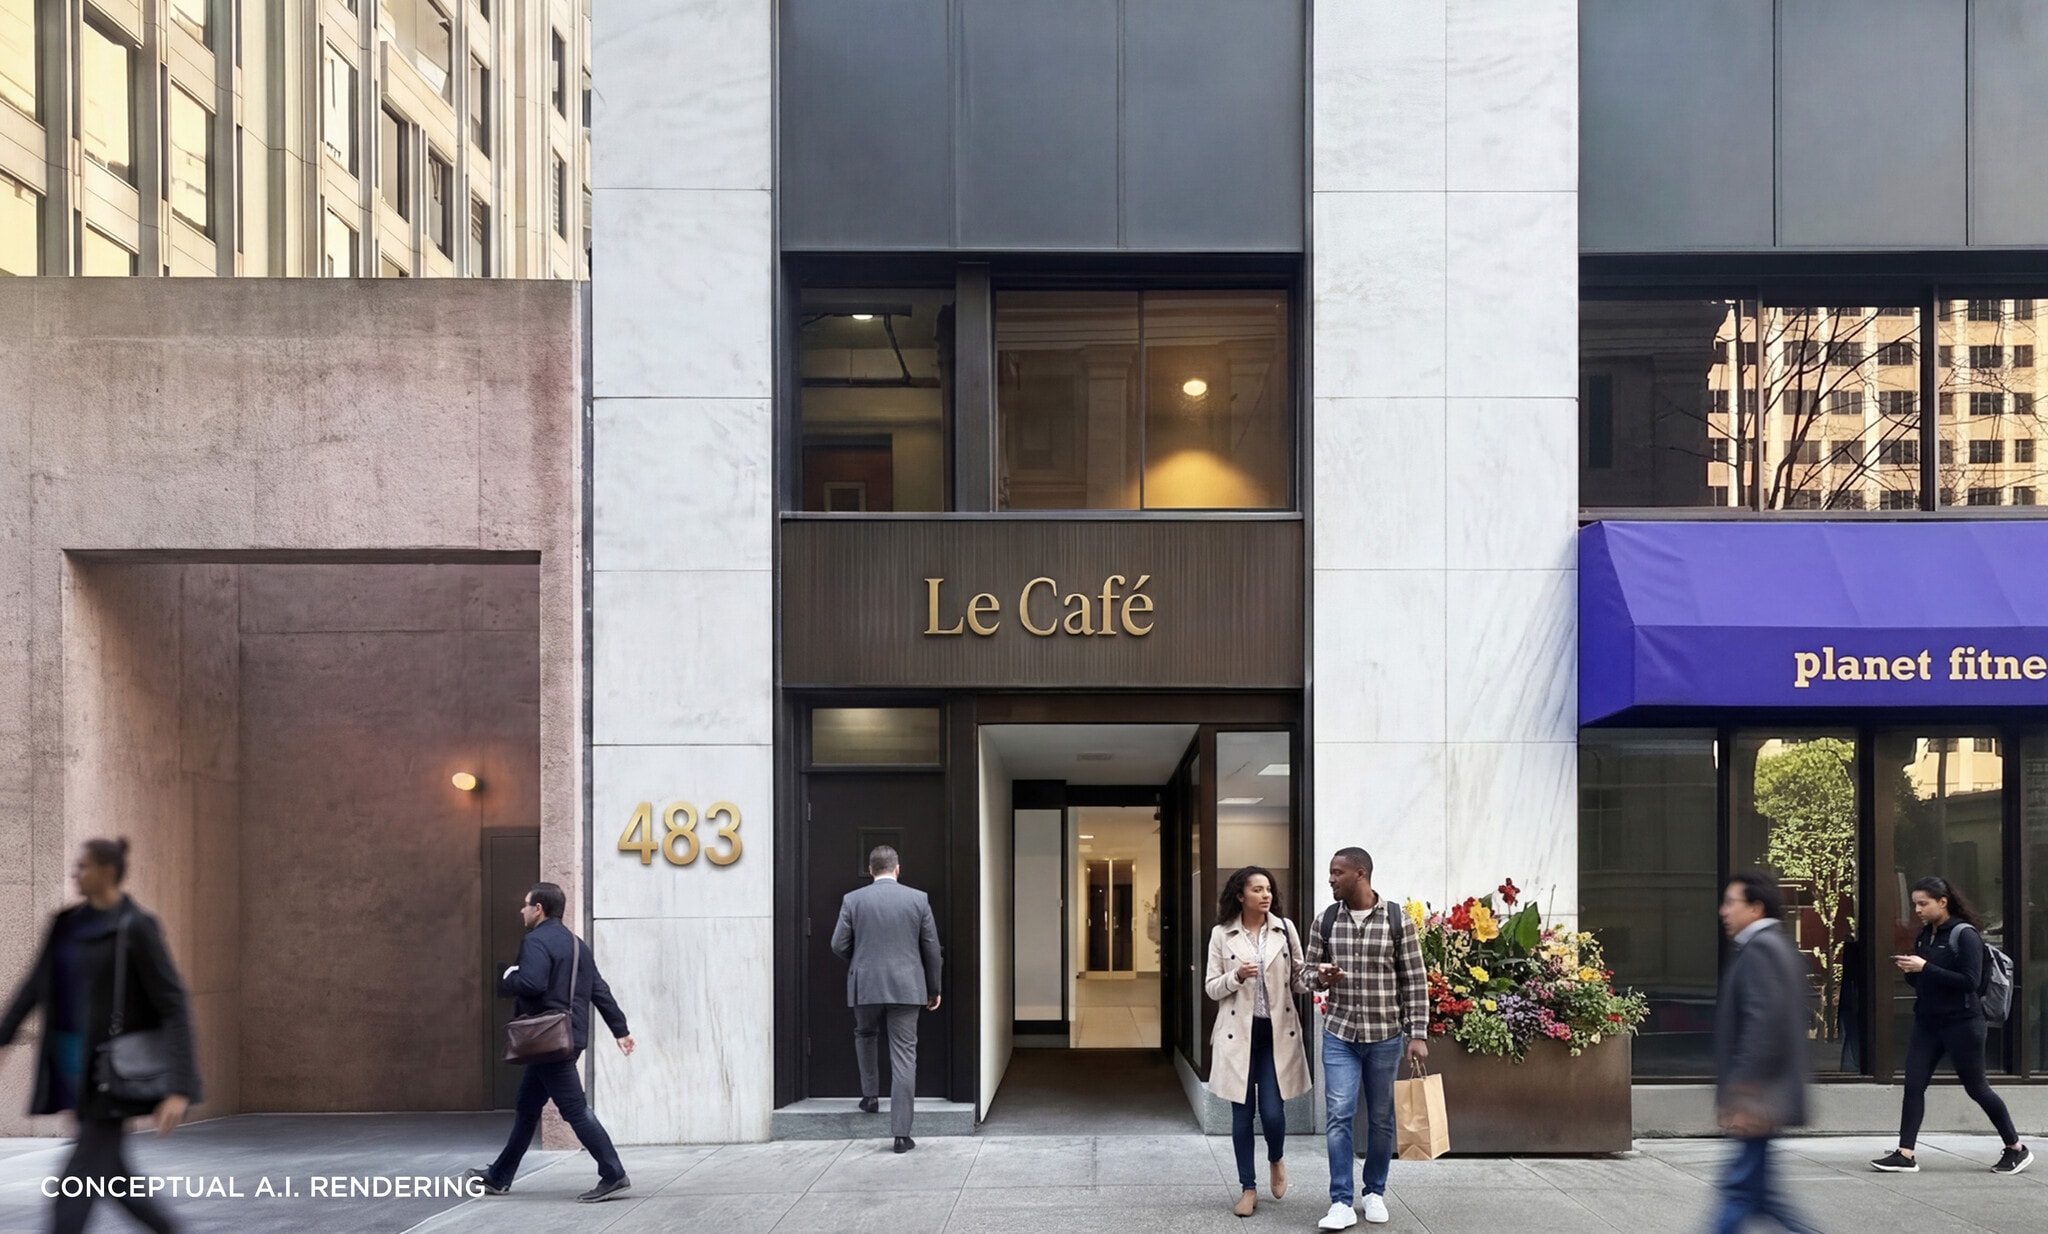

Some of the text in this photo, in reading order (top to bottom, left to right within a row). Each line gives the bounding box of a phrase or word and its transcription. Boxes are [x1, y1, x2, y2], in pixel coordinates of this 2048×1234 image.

[924, 574, 1154, 636] Le Café
[1794, 646, 2048, 688] planet fitne
[617, 801, 742, 866] 483
